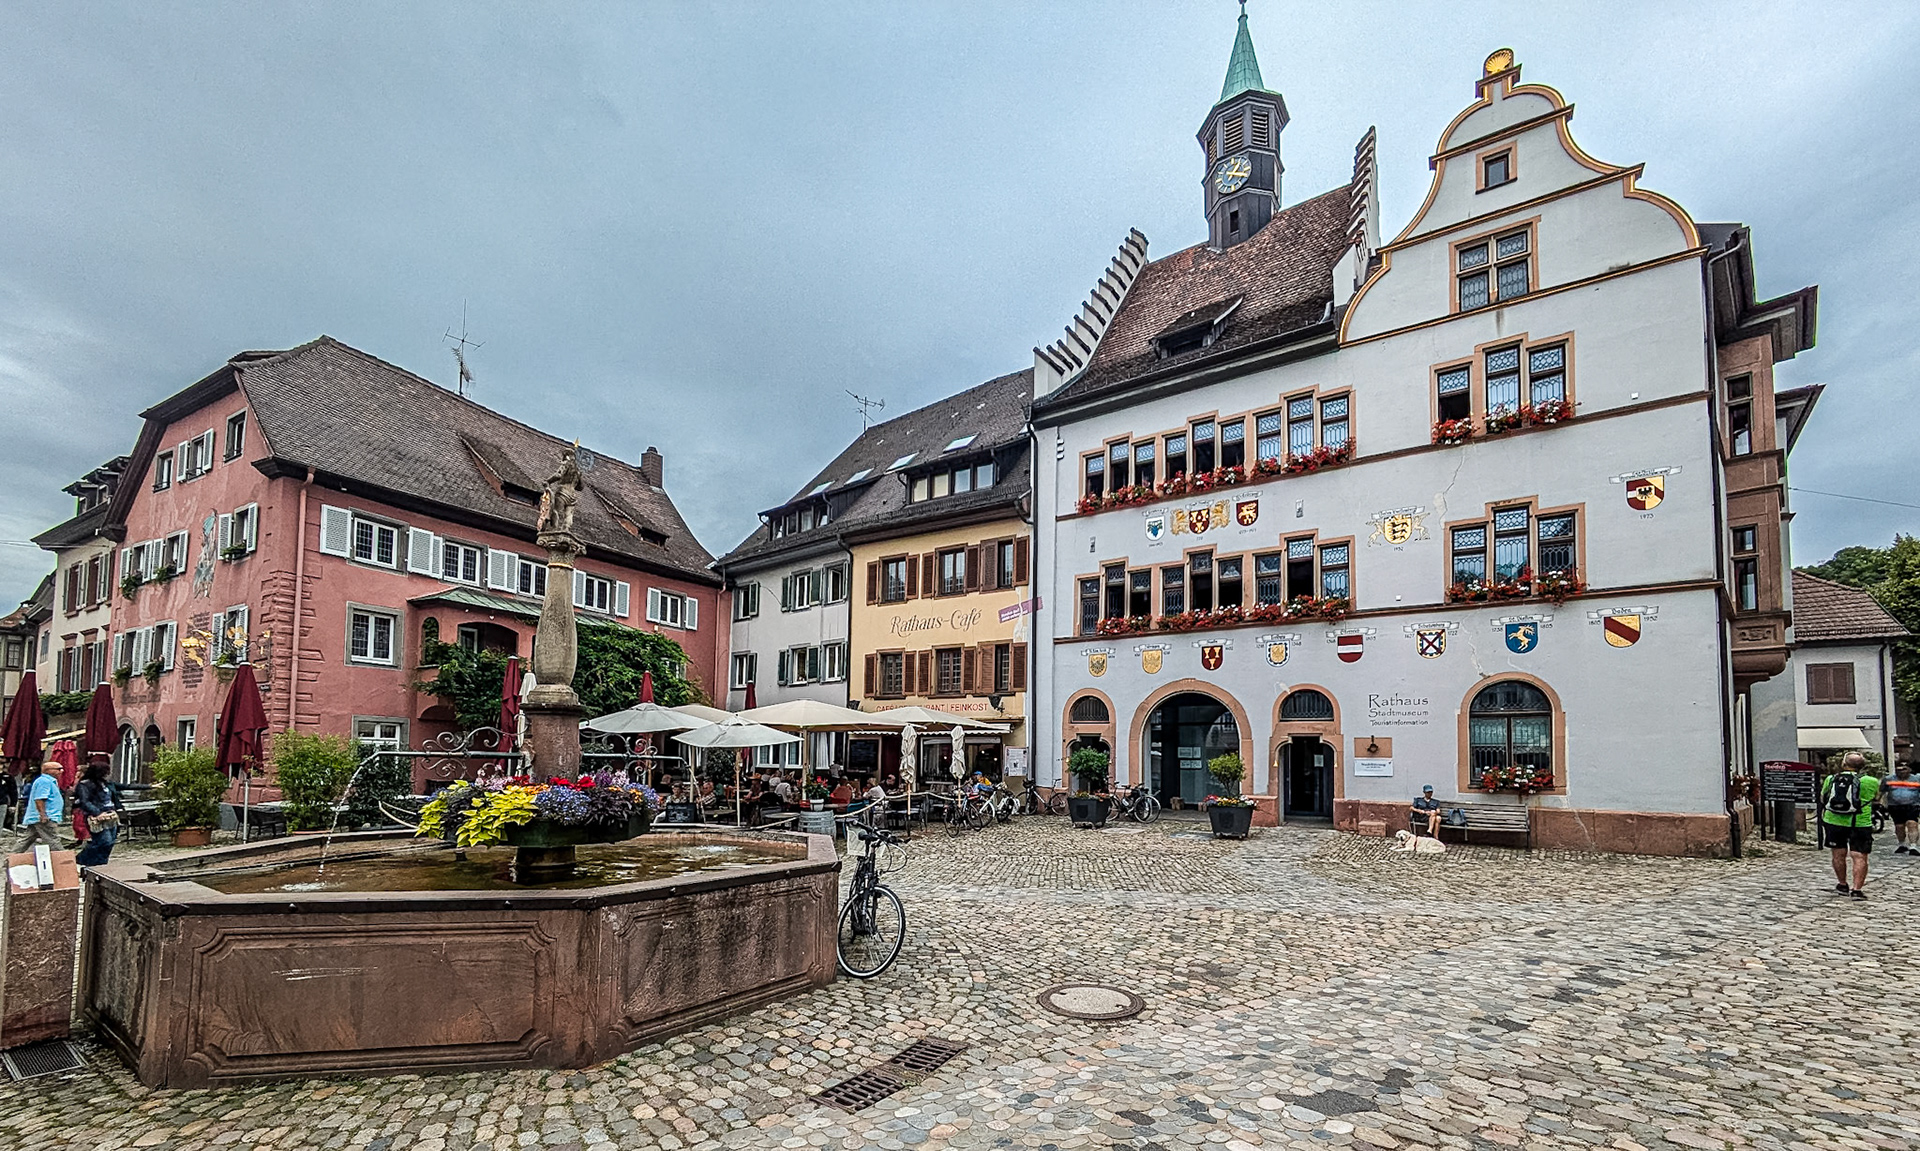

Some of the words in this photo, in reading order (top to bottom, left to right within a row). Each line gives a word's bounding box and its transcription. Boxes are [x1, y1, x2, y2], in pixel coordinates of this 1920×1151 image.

[890, 608, 982, 638] Rathaus-Café
[1368, 692, 1429, 708] Rathaus
[950, 703, 989, 712] FEINKOST
[1368, 708, 1429, 718] Stadtmuseum
[1370, 719, 1429, 727] Touristinformation
